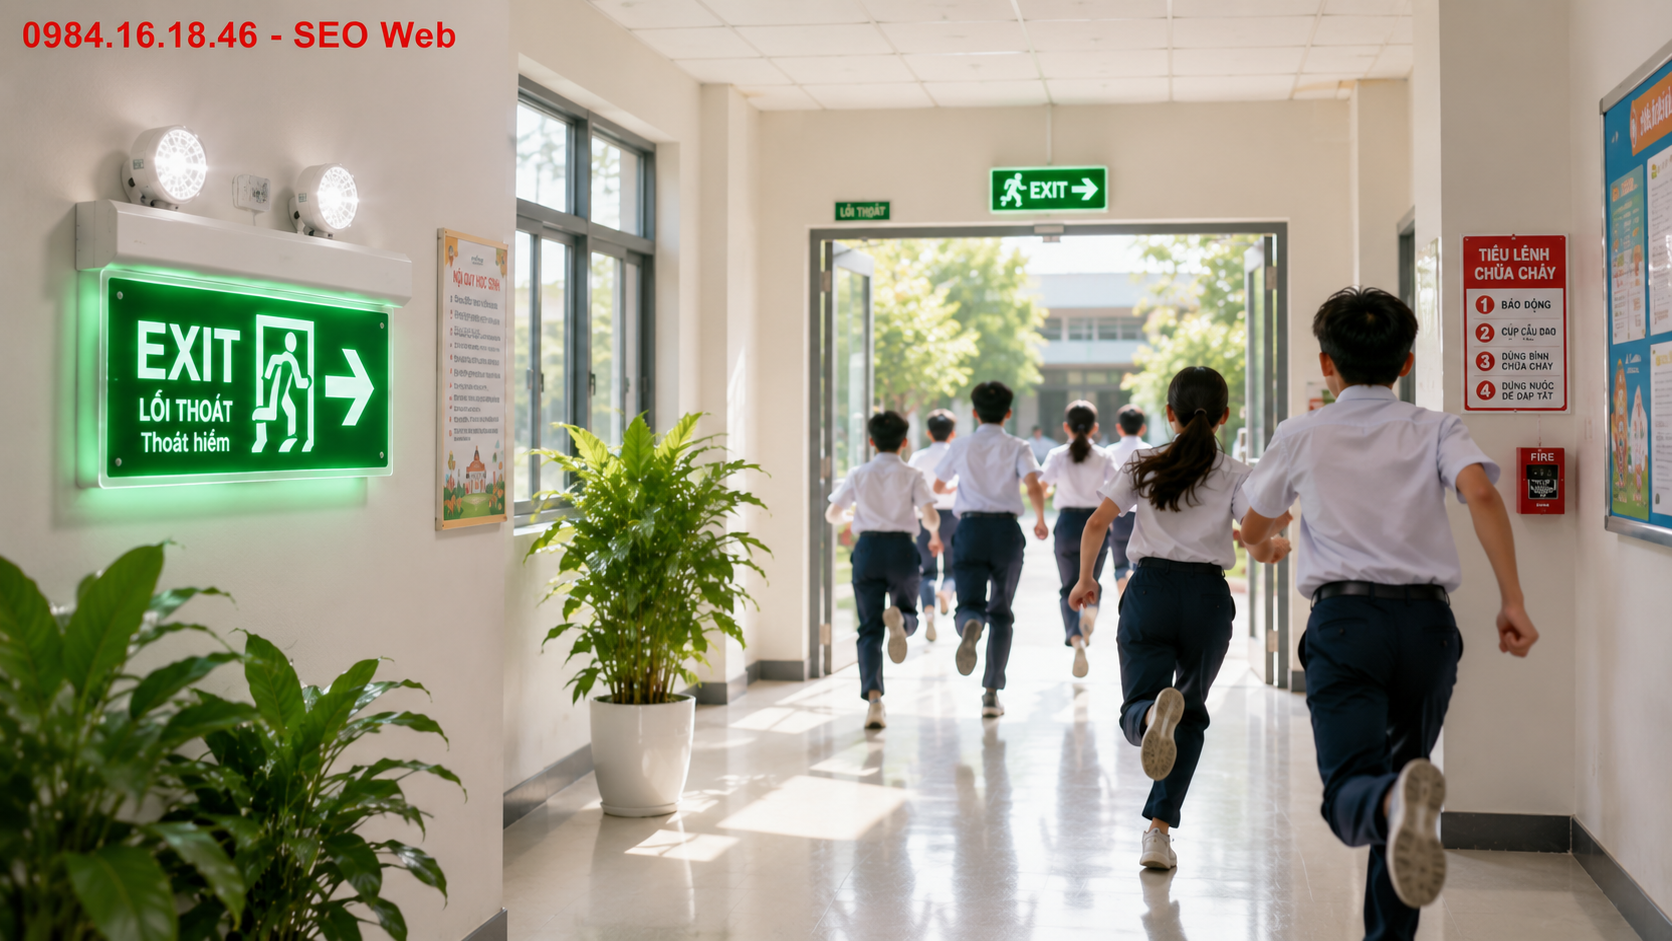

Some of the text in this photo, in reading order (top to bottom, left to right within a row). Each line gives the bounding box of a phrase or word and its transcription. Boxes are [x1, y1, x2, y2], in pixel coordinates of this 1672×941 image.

[1030, 181, 1068, 199] EXIT
[1480, 297, 1488, 312] 1
[1480, 326, 1490, 340] 2
[137, 320, 241, 383] EXIT
[1480, 354, 1490, 369] 3
[1480, 383, 1491, 398] 4
[175, 393, 233, 423] THOÁT
[140, 431, 189, 453] Thoát
[1530, 452, 1555, 462] FIRE
